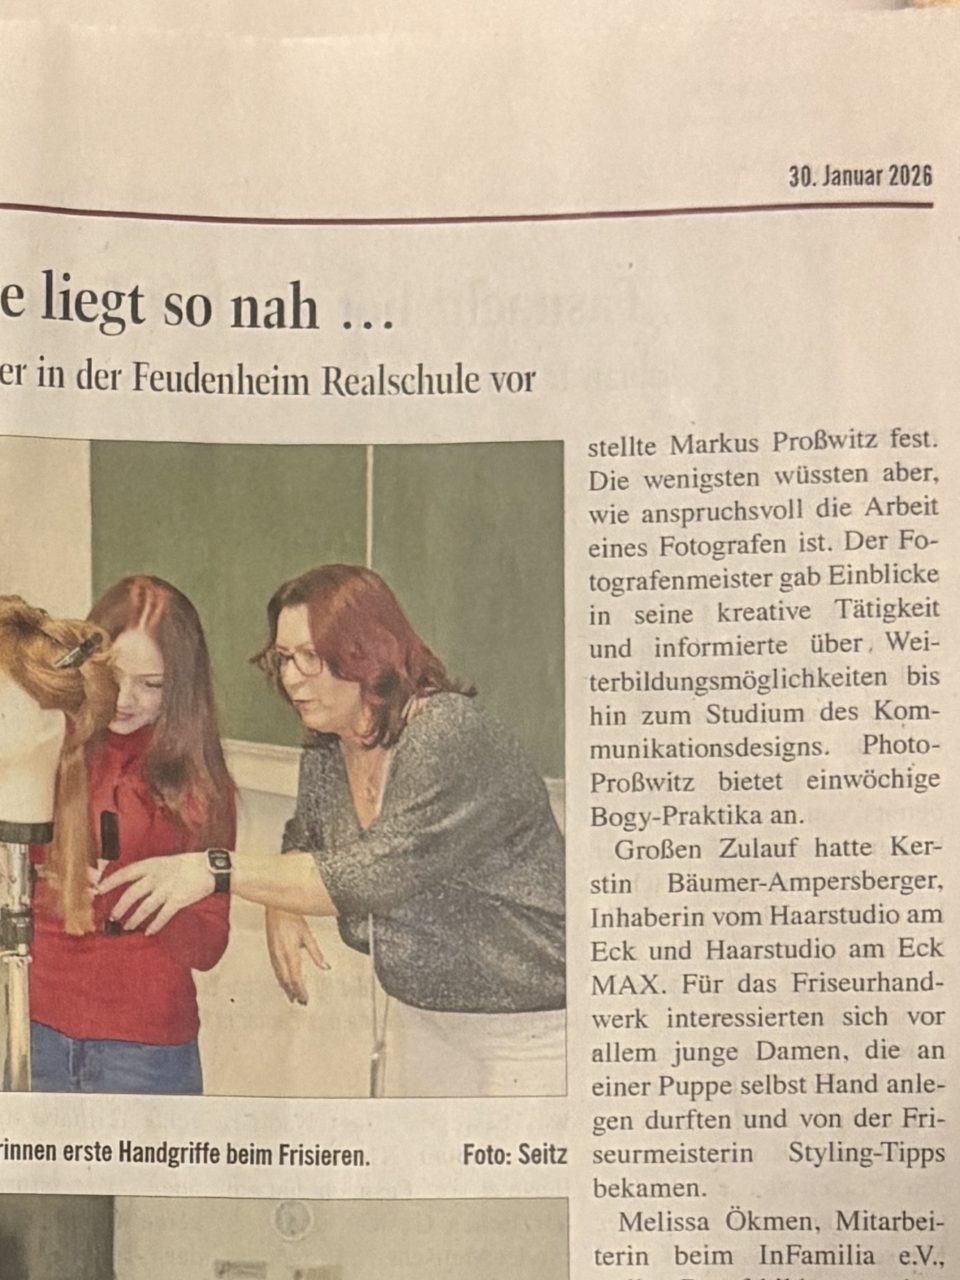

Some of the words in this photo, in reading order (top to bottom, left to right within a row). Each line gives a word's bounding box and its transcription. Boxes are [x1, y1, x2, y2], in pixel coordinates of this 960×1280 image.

[789, 164, 817, 188] 30.
[821, 164, 884, 187] Januar
[888, 163, 933, 187] 2026
[40, 268, 147, 338] liegt
[163, 292, 213, 328] so
[230, 279, 320, 330] nah
[36, 354, 65, 389] in
[76, 357, 123, 391] der
[132, 360, 310, 396] Feudenheim
[321, 361, 481, 397] Realschule
[489, 371, 537, 393] vor
[588, 435, 657, 458] stellte
[670, 432, 760, 456] Markus
[772, 428, 878, 452] Proßwitz
[890, 427, 938, 449] fest.
[588, 503, 630, 525] wie
[641, 497, 803, 529] anspruchsvoll
[815, 496, 852, 519] die
[864, 494, 940, 517] Arbeit
[590, 872, 632, 895] stin
[667, 869, 944, 898] Bäumer-Ampersberger,
[62, 1140, 113, 1163] erste
[118, 1139, 221, 1169] Handgriffe
[226, 1141, 273, 1166] beim
[278, 1143, 371, 1167] Frisieren.
[463, 1143, 512, 1166] Foto:
[517, 1142, 568, 1165] Seitz
[592, 1141, 754, 1164] seurmeisterin
[789, 1140, 946, 1169] Styling-Tipps
[594, 1244, 649, 1266] terin
[674, 1244, 734, 1266] beim
[759, 1243, 876, 1266] InFamilia
[898, 1244, 945, 1269] e.V.,
